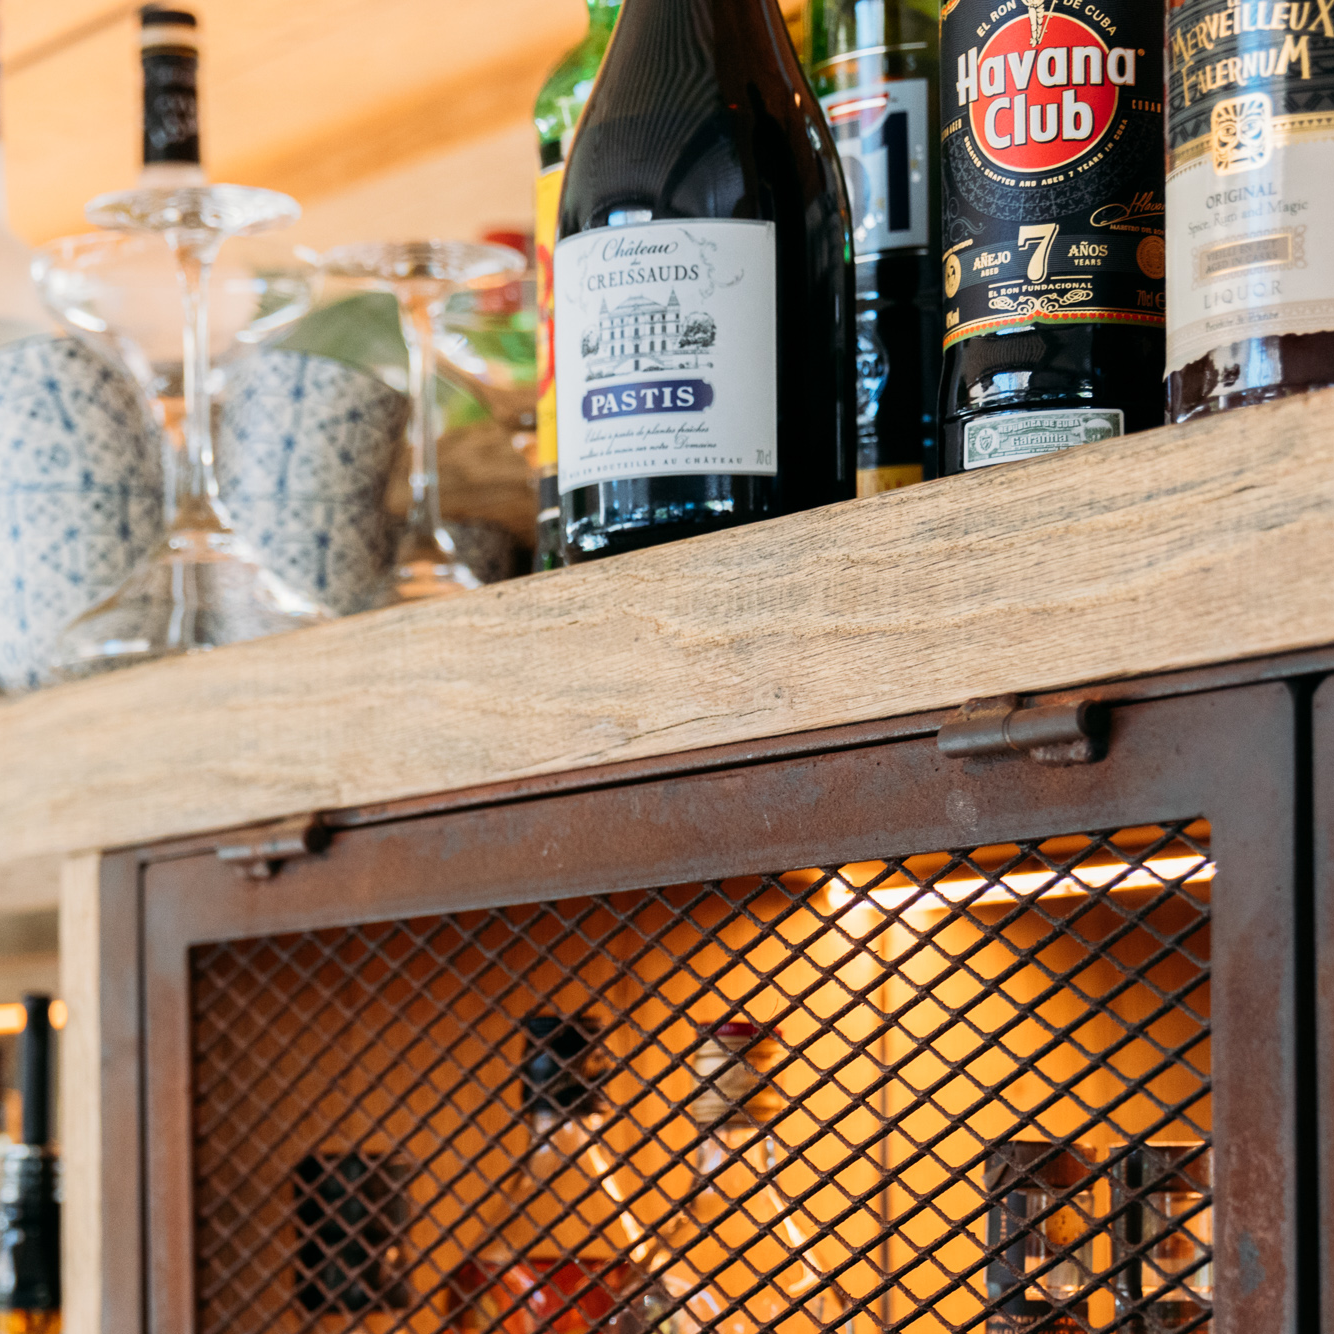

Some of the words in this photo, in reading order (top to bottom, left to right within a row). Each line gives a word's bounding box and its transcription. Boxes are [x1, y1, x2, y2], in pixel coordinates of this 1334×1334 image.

[976, 21, 992, 38] EL
[989, 0, 1018, 23] RON
[1084, 5, 1118, 37] CUBA
[956, 46, 1137, 107] Havana
[1181, 34, 1312, 107] FALERNUM
[983, 89, 1095, 150] Club
[1019, 176, 1038, 188] AND
[1041, 174, 1065, 187] AGED
[1076, 152, 1105, 173] YEARS
[1105, 142, 1115, 153] IN
[1113, 118, 1129, 141] CUBA
[1205, 182, 1278, 210] ORIGINAL
[1213, 212, 1238, 228] Rum
[1241, 202, 1263, 220] and
[1267, 199, 1309, 216] Magic
[602, 236, 679, 262] Château
[972, 250, 1012, 271] AÑEJO
[1017, 222, 1060, 284] 7
[1067, 241, 1109, 257] AÑOS
[1073, 258, 1102, 266] YEARS
[587, 264, 700, 292] CREISSAUDS
[980, 267, 1000, 278] AGED
[1203, 280, 1282, 310] LIQUOR
[590, 385, 696, 417] PASTIS
[663, 457, 678, 466] AU
[685, 454, 744, 465] CHÂTEAU
